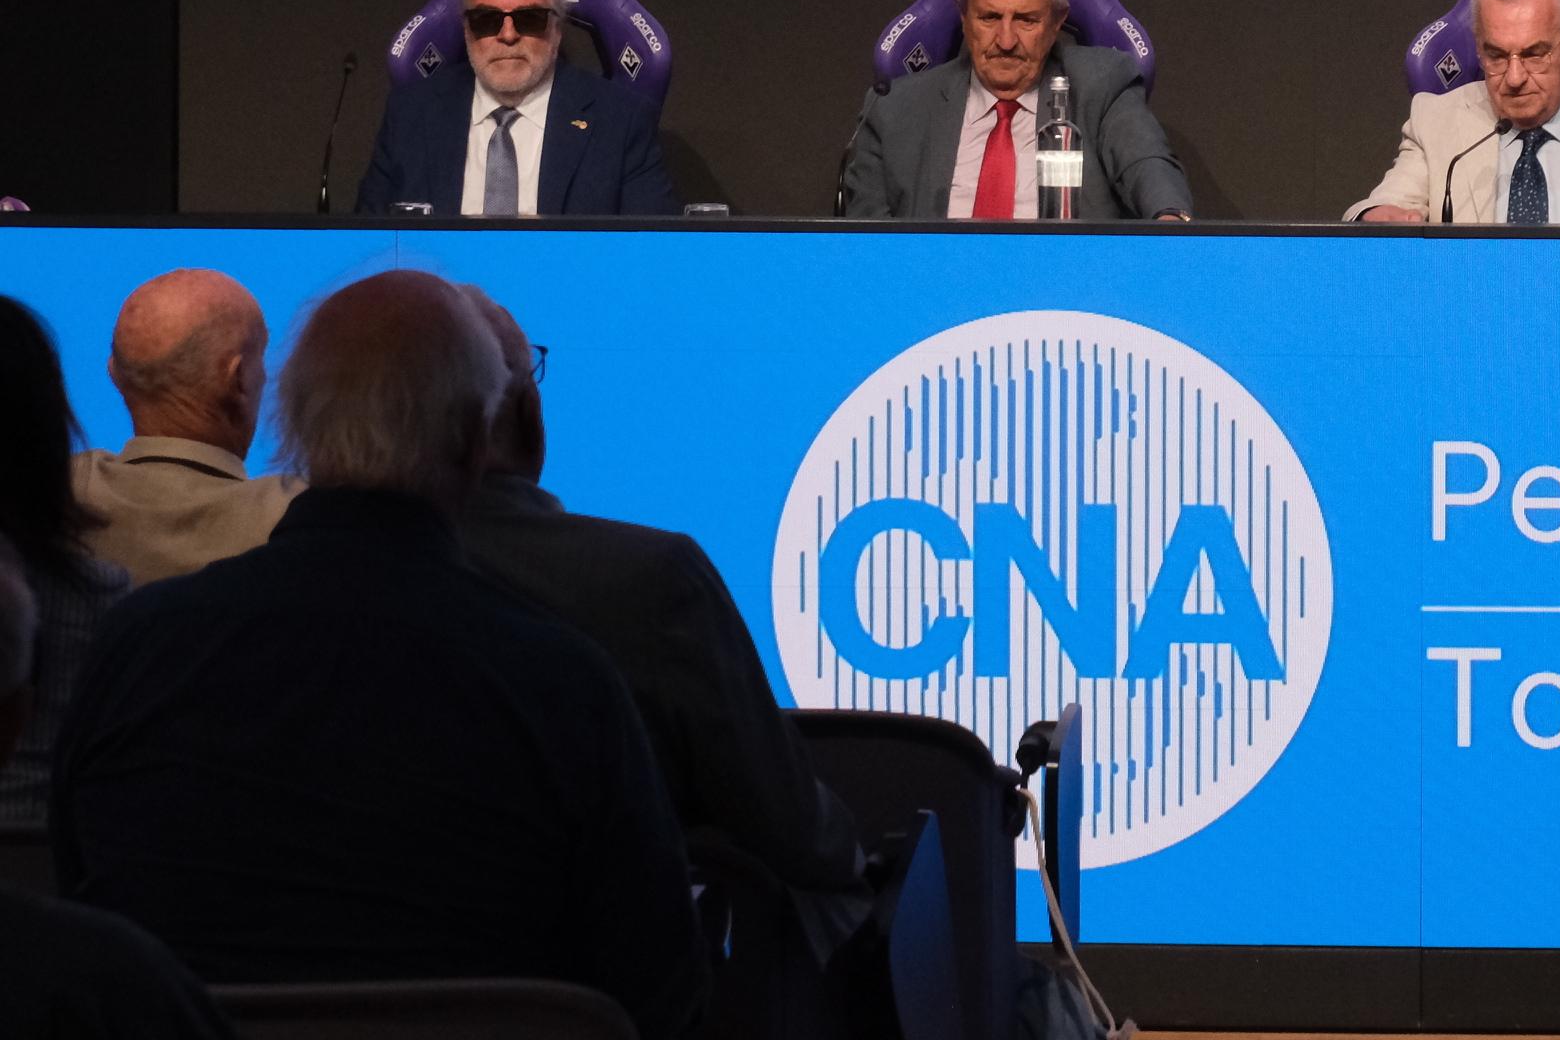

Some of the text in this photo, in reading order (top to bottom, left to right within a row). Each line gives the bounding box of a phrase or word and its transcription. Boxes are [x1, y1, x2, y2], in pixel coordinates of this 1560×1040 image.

[391, 14, 426, 58] sparco
[630, 13, 662, 54] sparco
[880, 13, 917, 53] sparco
[1117, 17, 1149, 58] sparco
[1411, 20, 1448, 56] sparco
[819, 496, 1285, 681] CNA
